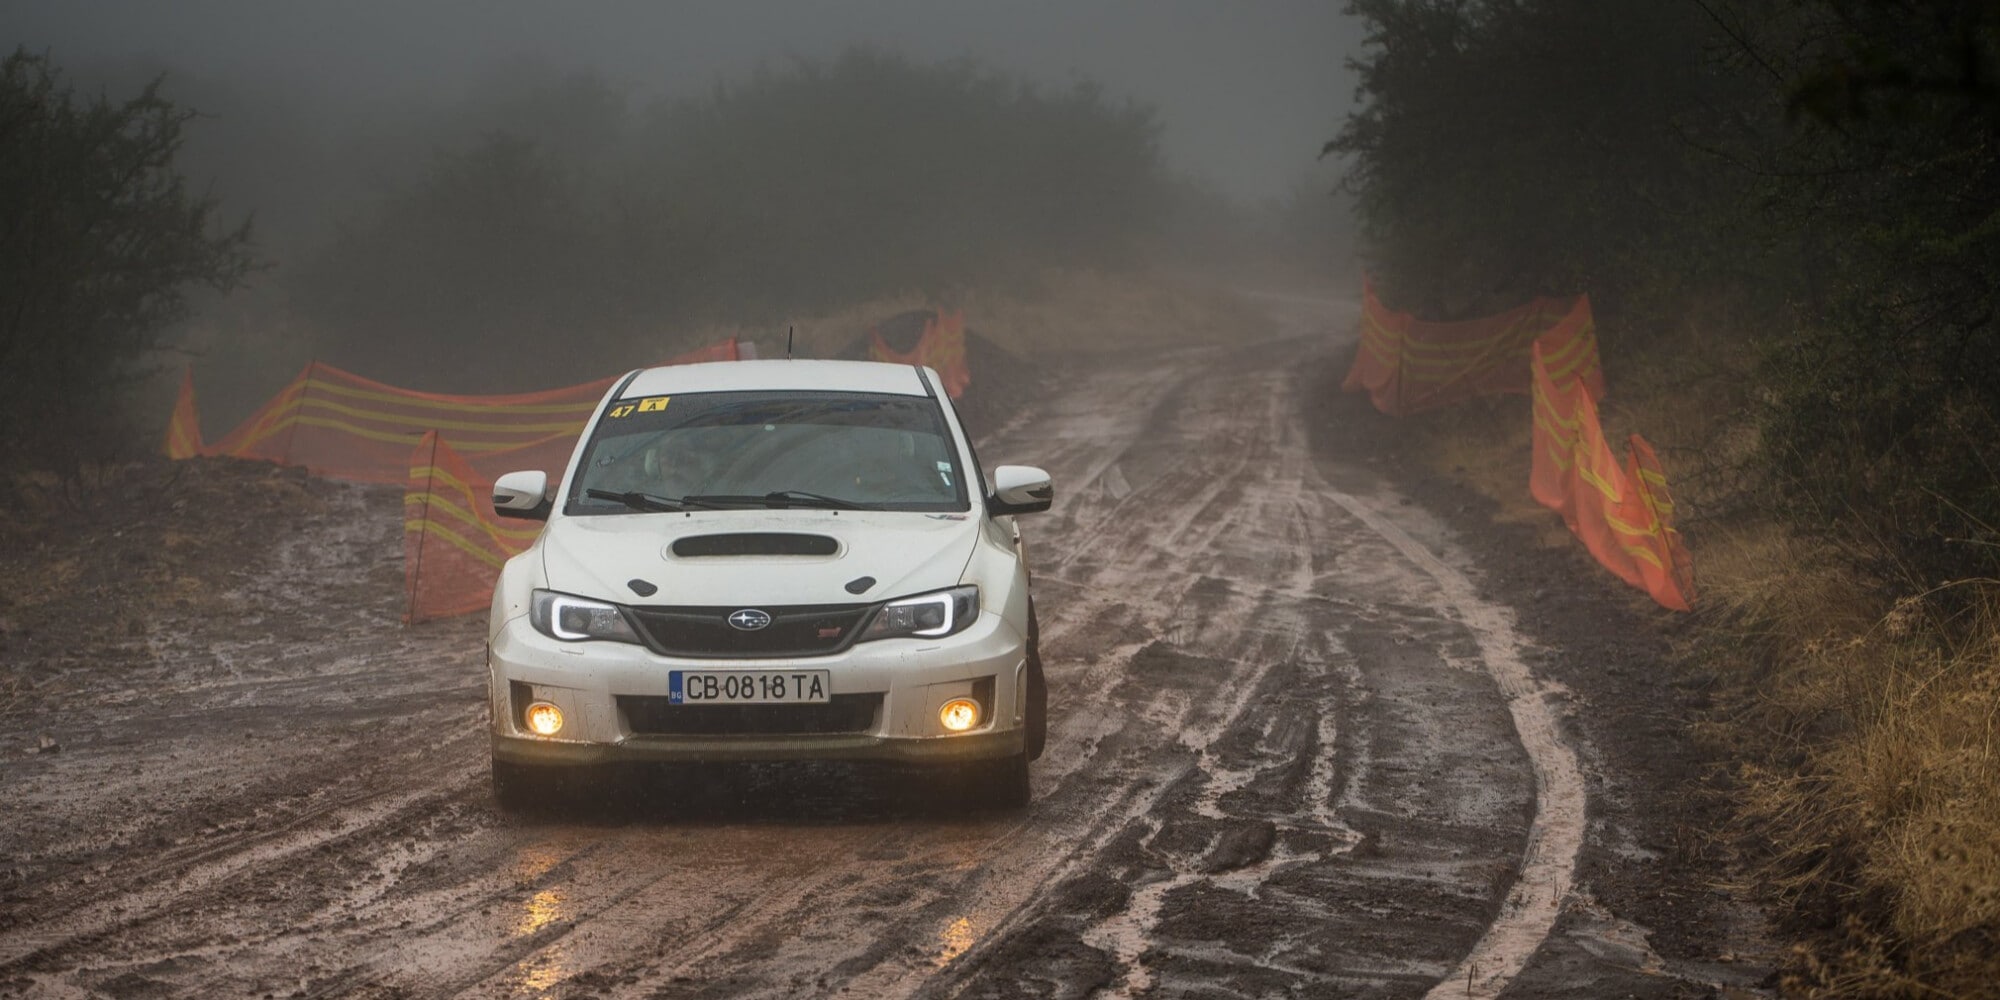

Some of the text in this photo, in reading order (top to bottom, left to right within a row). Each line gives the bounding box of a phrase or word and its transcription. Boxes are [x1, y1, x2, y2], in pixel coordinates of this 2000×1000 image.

[609, 405, 635, 418] 47
[686, 674, 824, 700] CB 0818 TA
[671, 691, 682, 700] BG
